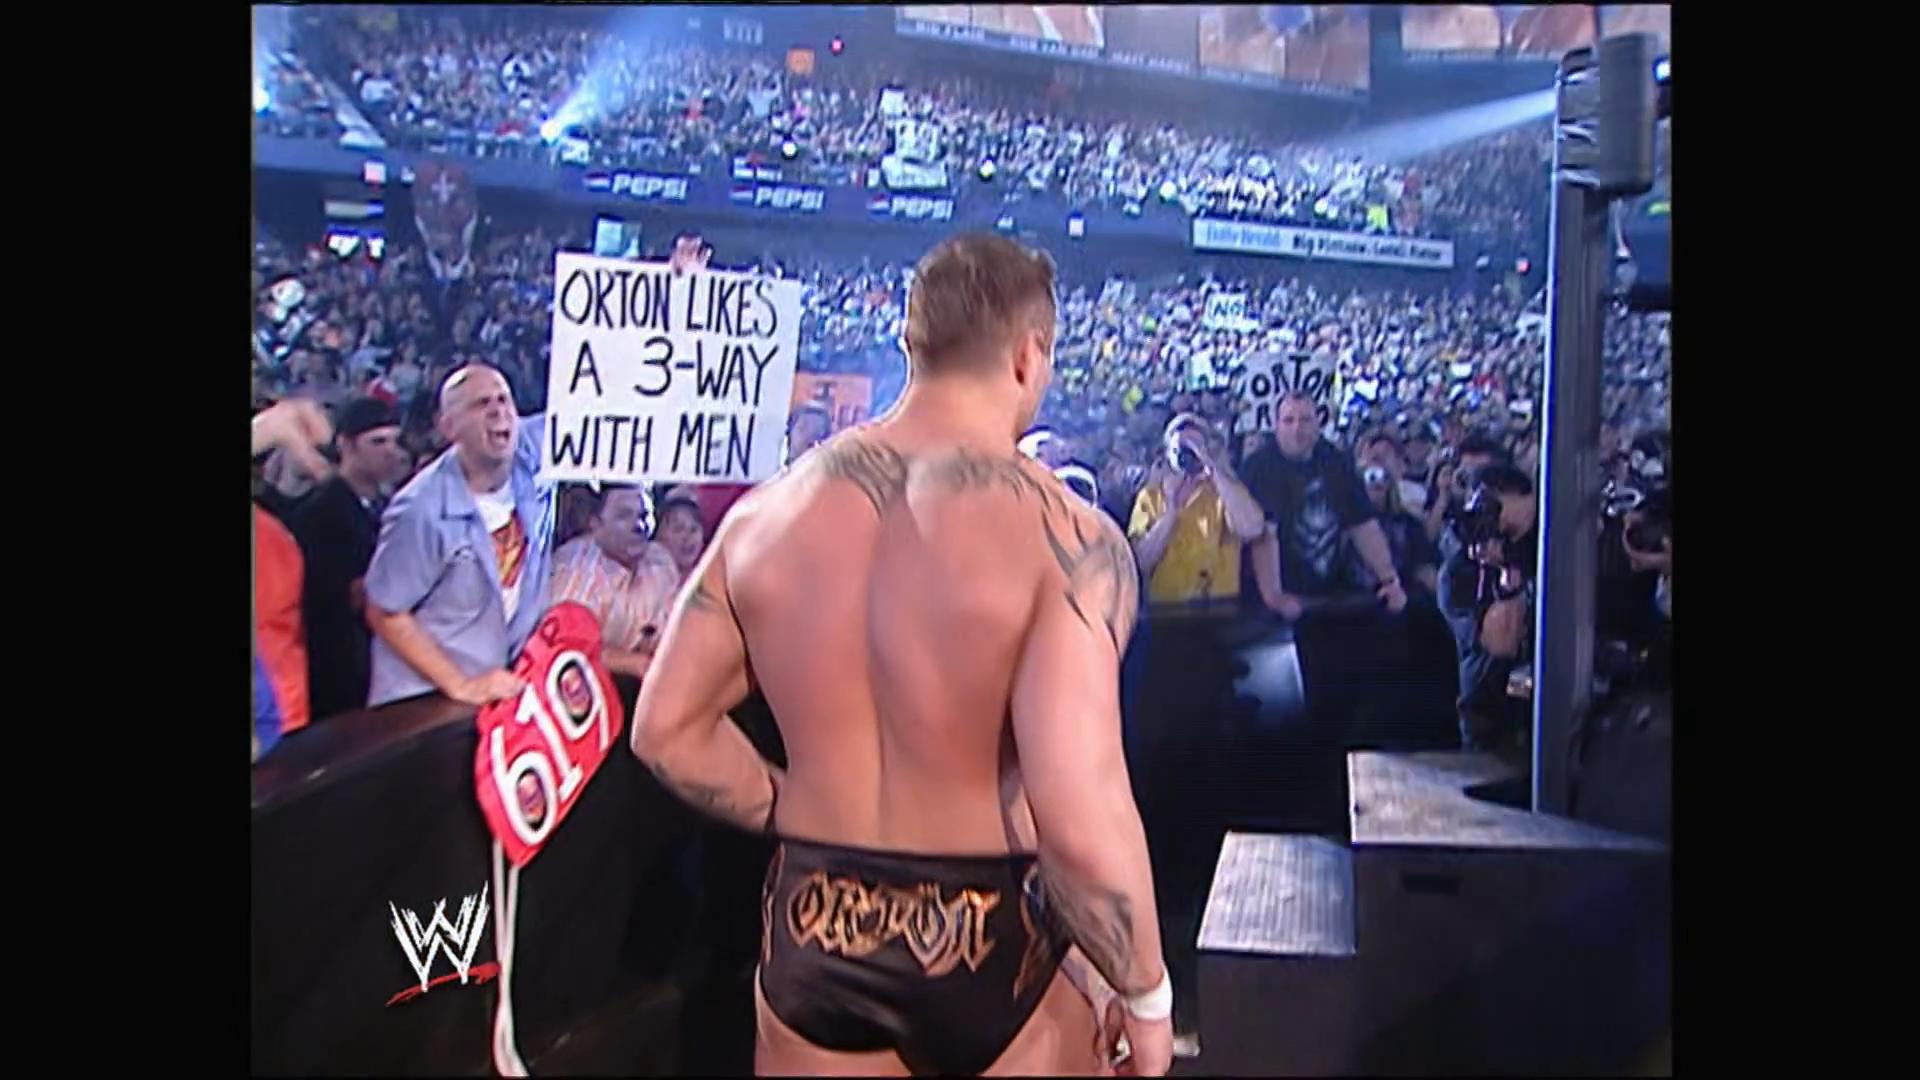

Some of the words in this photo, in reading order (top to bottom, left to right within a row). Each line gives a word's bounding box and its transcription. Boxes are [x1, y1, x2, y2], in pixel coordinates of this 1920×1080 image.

[611, 173, 688, 200] PEPSI
[754, 186, 825, 210] PEPSI
[891, 197, 954, 221] PEPSI
[560, 268, 671, 333] ORTON
[686, 273, 778, 338] LIKES
[569, 340, 602, 396] A
[633, 337, 779, 407] 3-WAY
[1251, 355, 1336, 403] ORTON
[550, 412, 653, 474] WITH
[671, 412, 755, 477] MEN
[489, 649, 611, 846] 619
